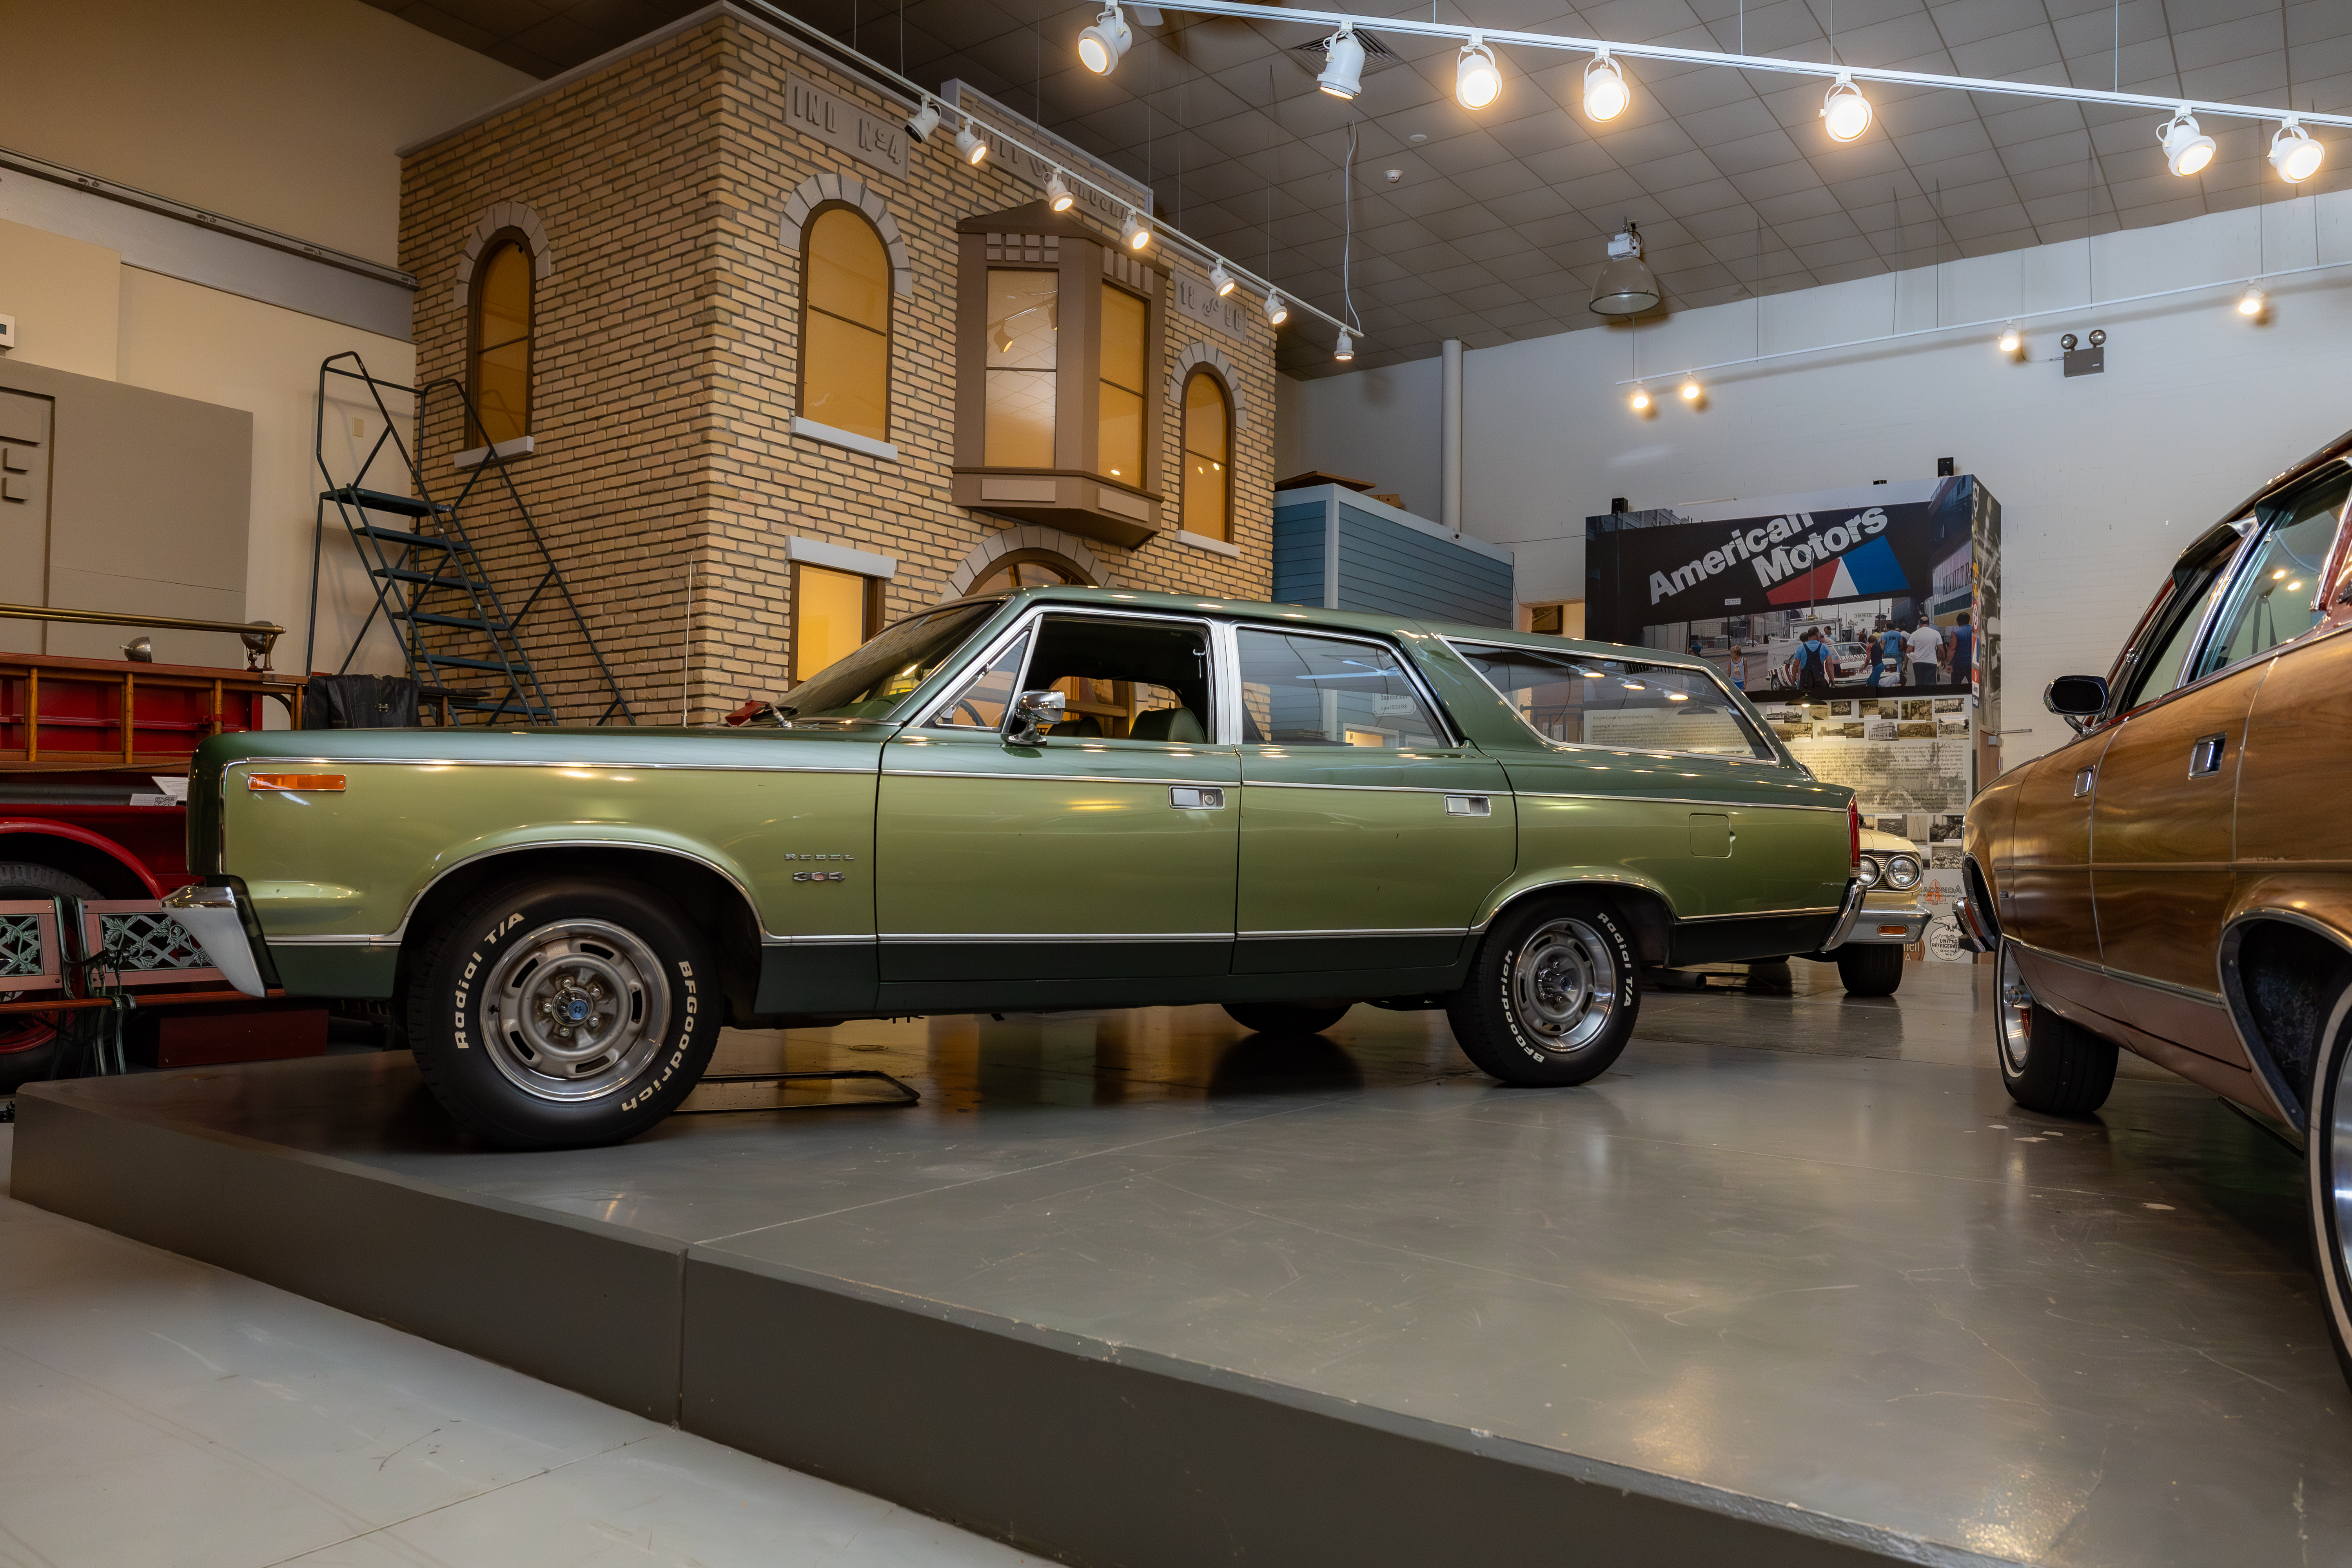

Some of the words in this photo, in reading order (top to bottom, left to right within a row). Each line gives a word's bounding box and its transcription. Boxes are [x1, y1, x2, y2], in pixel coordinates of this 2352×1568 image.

[794, 85, 838, 134] IND
[1180, 281, 1196, 309] 18
[1650, 512, 1814, 605] American
[1751, 508, 1888, 587] Motors
[1920, 885, 1962, 894] ACONDA
[455, 951, 483, 1049] Radial
[484, 912, 525, 945] T/A
[1501, 949, 1545, 1063] BFGoodrich
[1597, 912, 1632, 969] Radial
[1623, 976, 1634, 1007] T/A
[621, 960, 698, 1112] BFGoodrich
